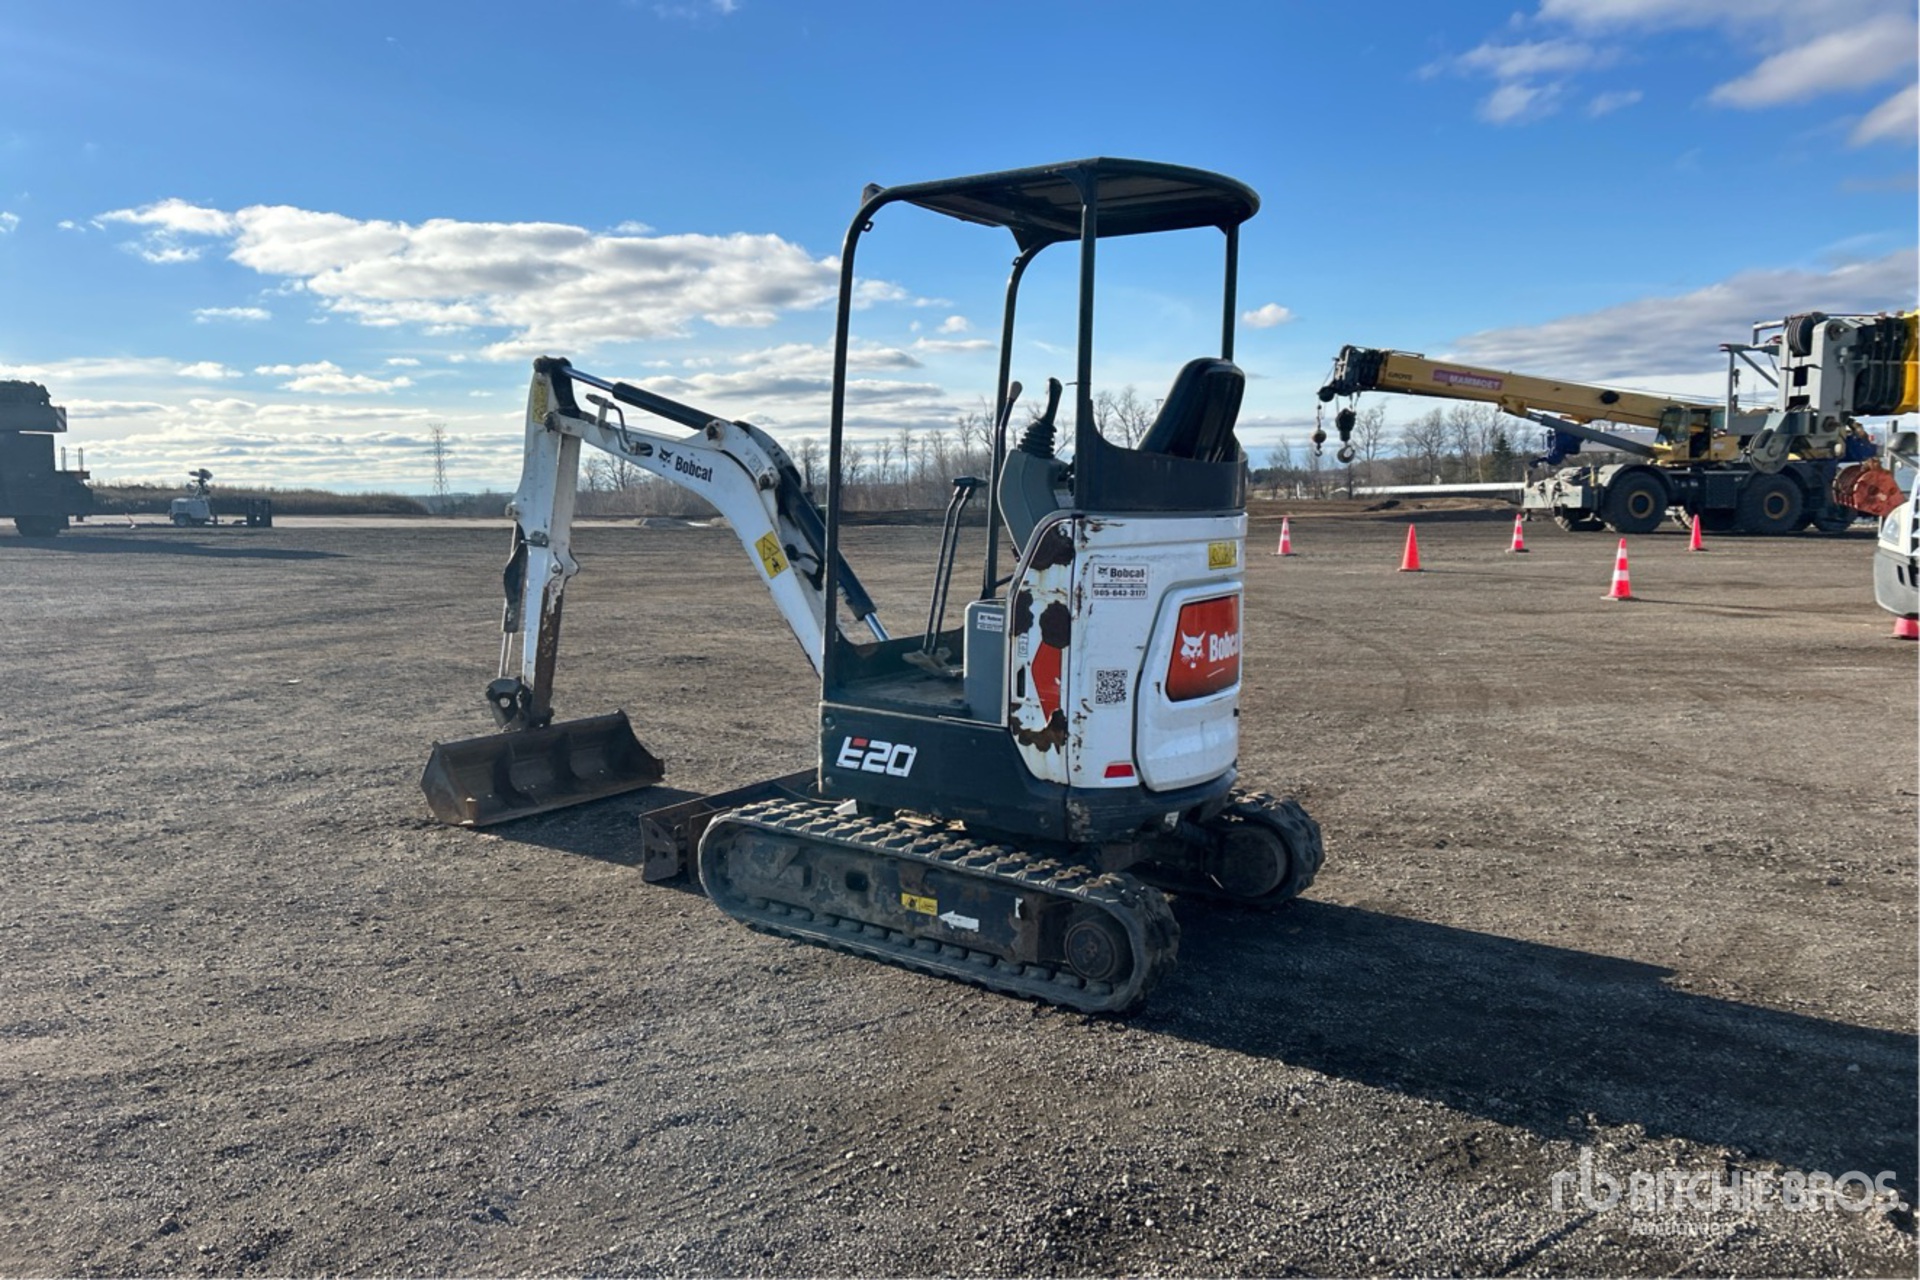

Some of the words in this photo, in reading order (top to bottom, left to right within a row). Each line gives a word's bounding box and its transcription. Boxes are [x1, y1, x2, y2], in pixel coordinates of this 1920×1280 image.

[675, 455, 713, 483] Bobcat
[1110, 567, 1145, 578] Bobcat
[836, 736, 918, 778] E20
